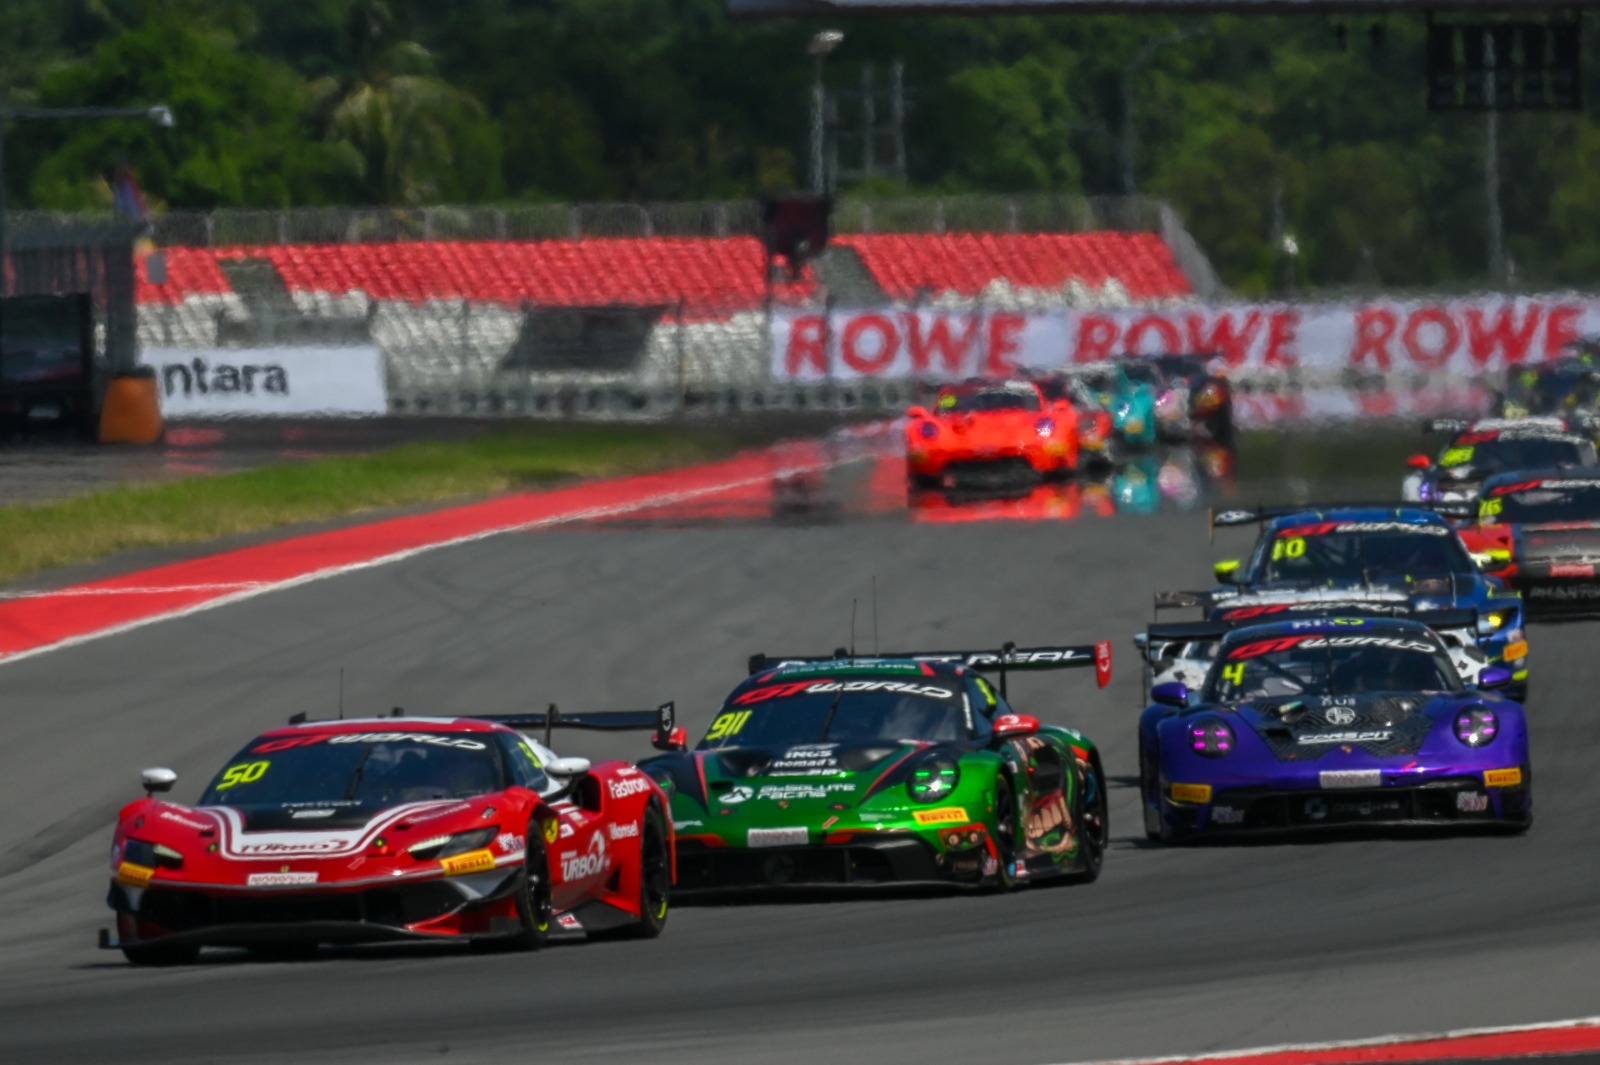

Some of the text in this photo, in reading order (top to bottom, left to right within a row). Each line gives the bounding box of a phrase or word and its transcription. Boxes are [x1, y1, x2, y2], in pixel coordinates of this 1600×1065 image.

[785, 313, 1026, 376] ROWE
[1072, 309, 1297, 368] ROWE
[1352, 302, 1587, 371] ROWE
[1222, 662, 1245, 686] 4
[706, 710, 753, 741] 911
[216, 760, 271, 790] 50
[447, 853, 491, 873] PIRELLI
